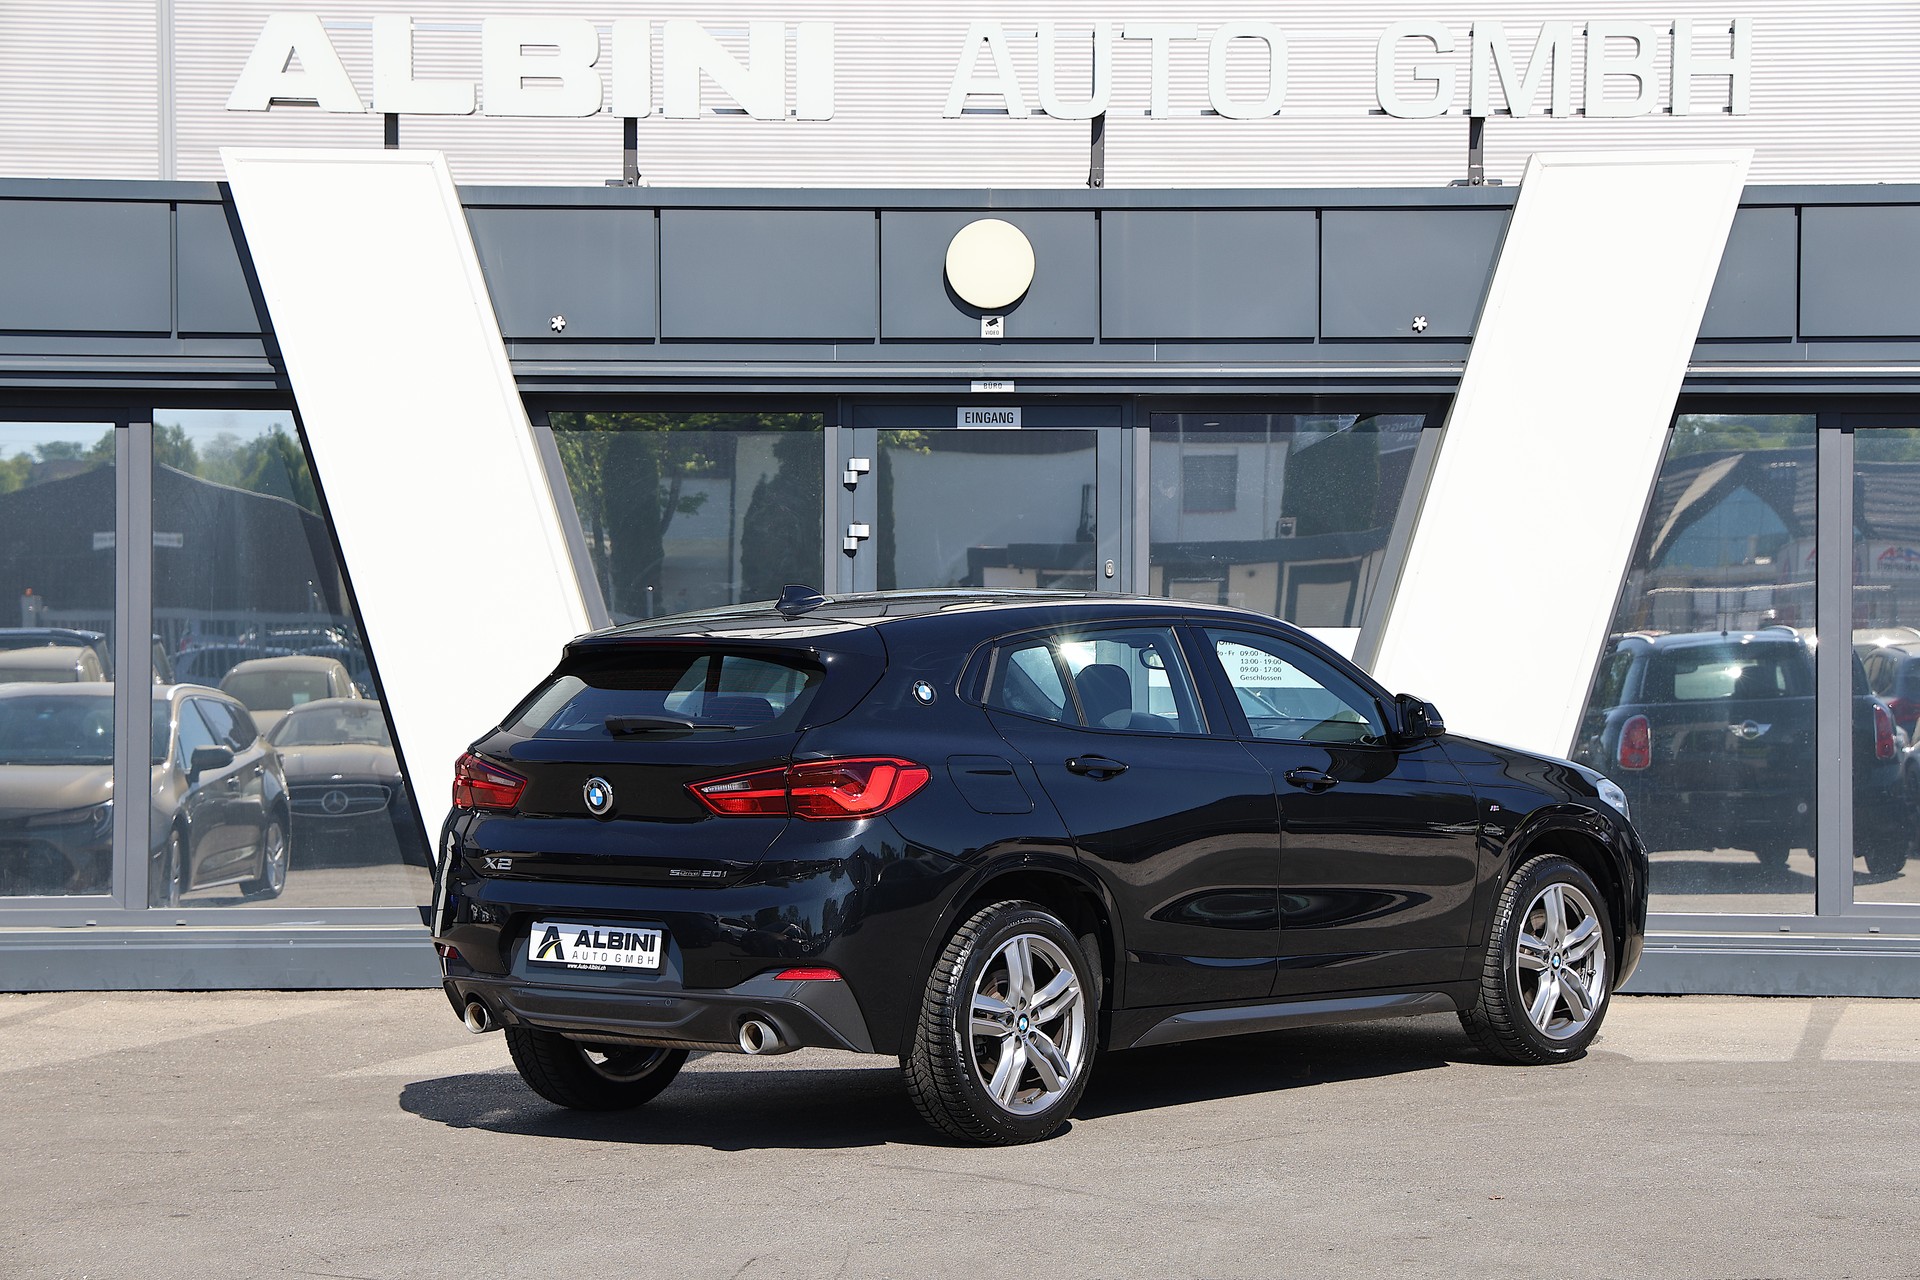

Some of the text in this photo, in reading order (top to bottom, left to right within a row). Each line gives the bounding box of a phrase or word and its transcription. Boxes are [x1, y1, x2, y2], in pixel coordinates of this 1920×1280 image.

[225, 13, 1753, 121] ALBINI AUTO GMBH
[983, 381, 1003, 390] BÜRO
[965, 411, 1014, 424] EINGANG
[481, 857, 513, 870] X2
[574, 930, 656, 952] ALBINI
[572, 950, 655, 965] AUTO GMBH
